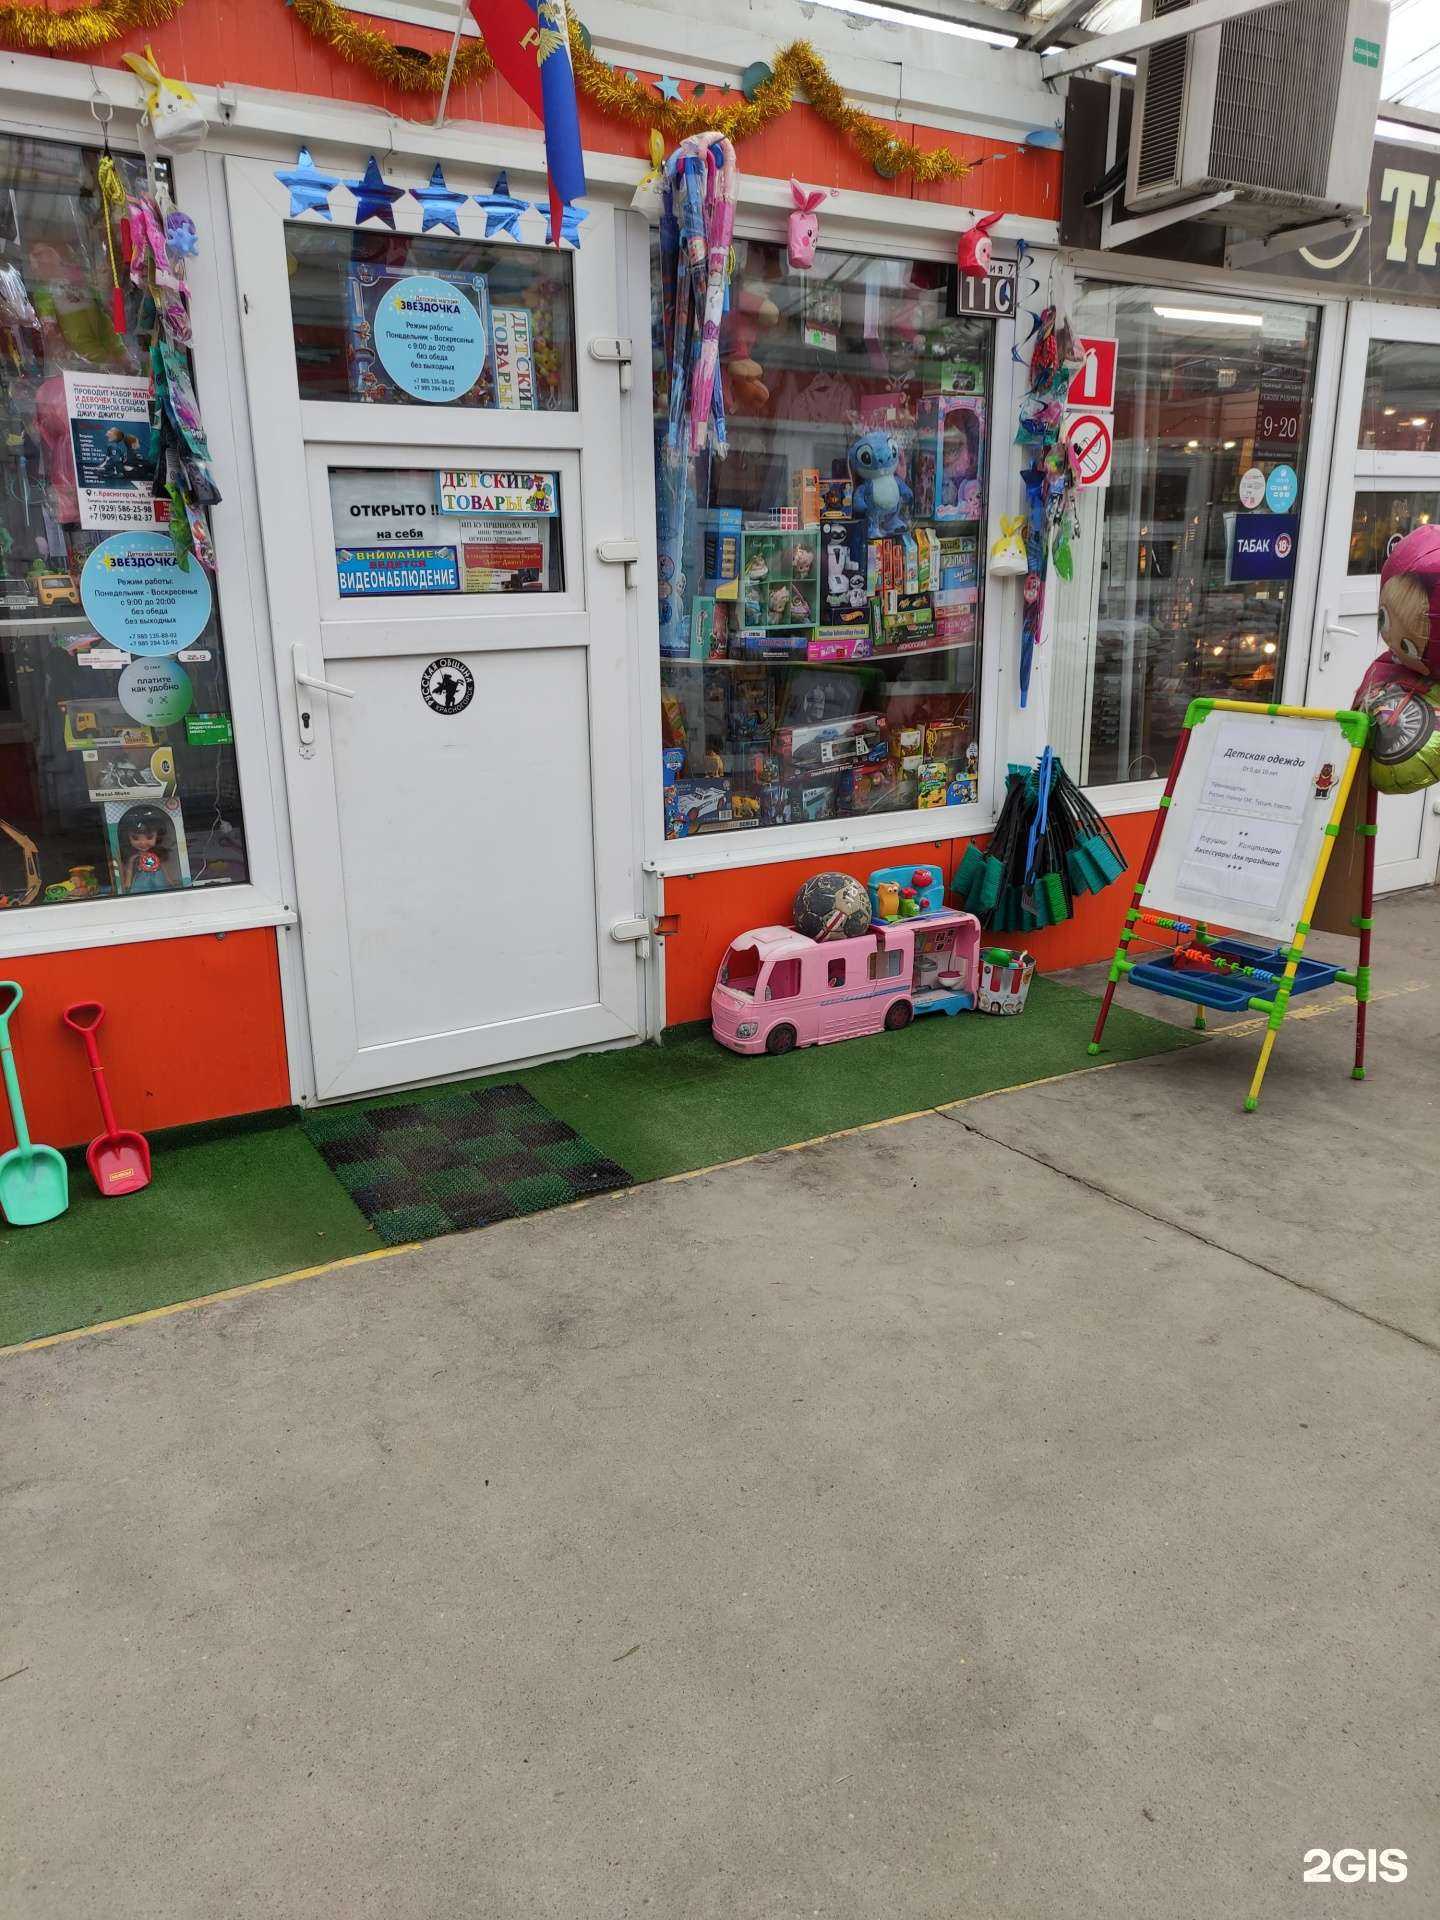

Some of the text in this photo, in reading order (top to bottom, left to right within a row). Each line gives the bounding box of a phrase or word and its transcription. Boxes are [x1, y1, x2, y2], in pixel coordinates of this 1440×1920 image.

[400, 300, 461, 314] ЗВЕЗДОЧКА
[494, 313, 513, 404] ТОВАРЫ
[74, 388, 152, 400] ПРОВОДИТ НАБОР МАЛЬ
[443, 472, 531, 489] ДЕТСКИЕ
[444, 494, 524, 511] ТОВАРЫ
[350, 504, 427, 517] ОТКРЫТО
[376, 529, 424, 539] на себя
[1237, 538, 1271, 553] ТАБАК
[110, 557, 179, 568] ЗВЕЗДОЧКА
[117, 578, 174, 587] Режим работы:
[340, 569, 456, 591] ВИДЕОНАБЛЮДЕНИЕ
[94, 589, 145, 598] Понедельник
[151, 588, 198, 597] Воскресенье
[126, 598, 143, 606] 9:00
[144, 599, 154, 607] до
[155, 598, 176, 606] 20:00
[131, 607, 168, 616] без обеда
[125, 617, 138, 625] без
[137, 676, 172, 685] платите
[148, 682, 180, 693] удобно
[1223, 748, 1306, 768] Детская одежда
